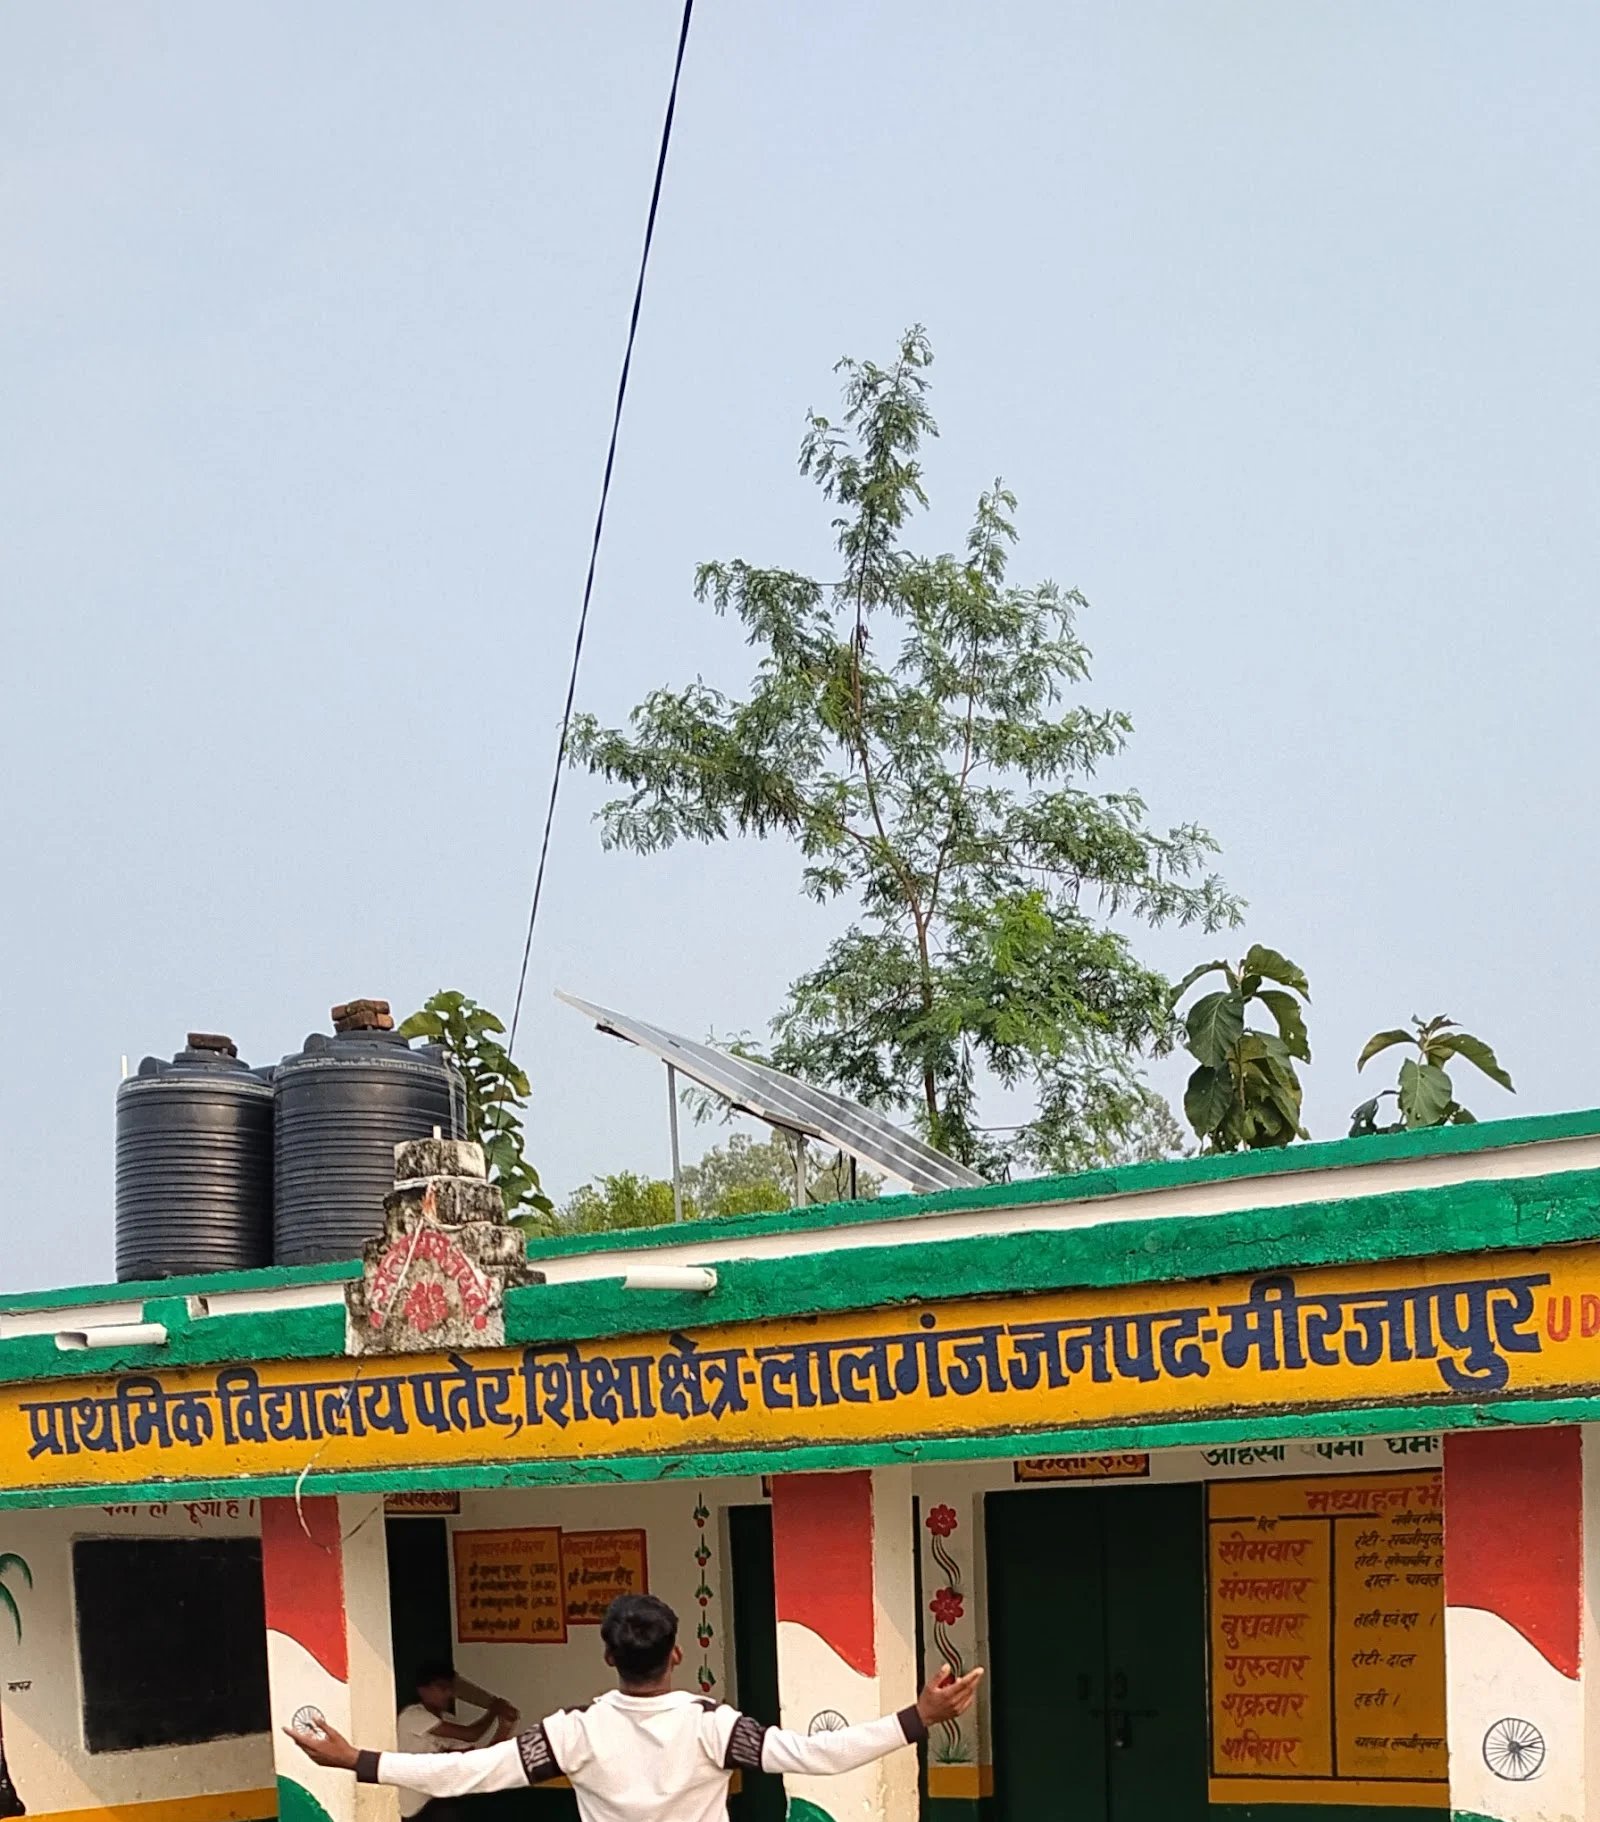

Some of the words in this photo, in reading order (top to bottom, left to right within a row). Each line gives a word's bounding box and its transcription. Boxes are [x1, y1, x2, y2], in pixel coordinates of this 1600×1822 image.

[19, 1375, 213, 1459] प्राथमिक
[214, 1366, 408, 1446] विद्यालय
[519, 1343, 656, 1430] शिक्षा
[1218, 1531, 1312, 1564] सोमवार
[1218, 1571, 1315, 1601] मंगलवार
[1221, 1613, 1311, 1649] बुधवार
[1221, 1693, 1308, 1727] शुक्रवार
